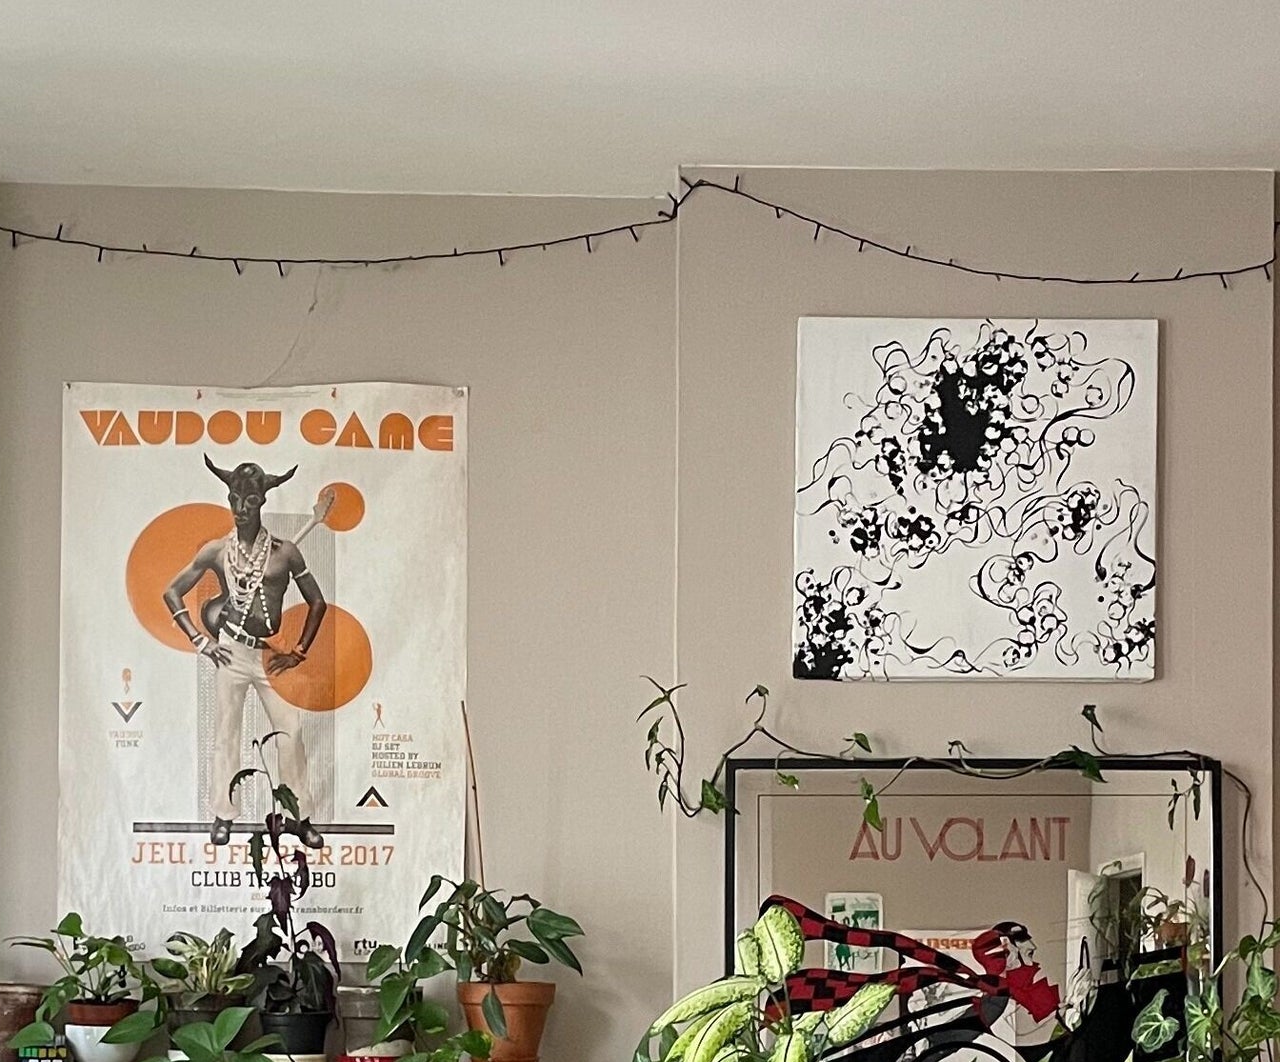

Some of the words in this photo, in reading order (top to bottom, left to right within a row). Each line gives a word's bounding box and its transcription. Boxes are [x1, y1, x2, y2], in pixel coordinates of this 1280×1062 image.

[79, 409, 281, 446] VAUDOU
[300, 408, 454, 451] GAME
[384, 743, 400, 751] SET
[372, 751, 405, 760] HOSTED
[372, 760, 404, 769] JULIEN
[848, 816, 902, 861] AU
[910, 816, 1071, 861] VOLANT
[131, 842, 193, 865] JEU.
[203, 842, 218, 865] 9
[340, 845, 395, 866] 2017
[191, 871, 242, 887] CLUB
